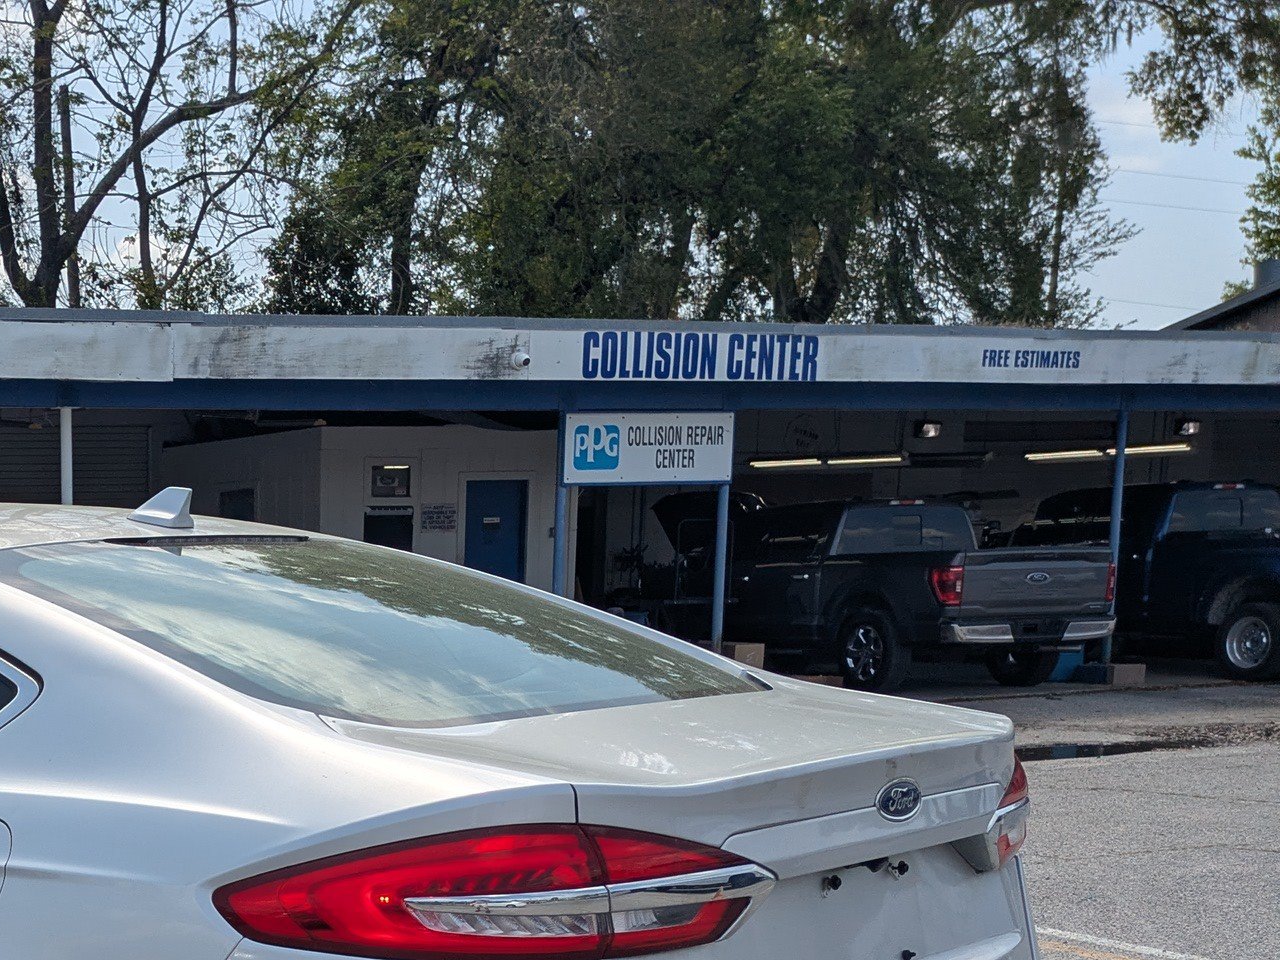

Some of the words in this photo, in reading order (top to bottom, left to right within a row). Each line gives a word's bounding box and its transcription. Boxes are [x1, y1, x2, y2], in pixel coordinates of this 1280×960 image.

[582, 331, 718, 380] COLLISION
[726, 333, 819, 382] CENTER
[982, 349, 1011, 368] FREE
[1014, 350, 1081, 369] ESTIMATES
[574, 424, 619, 463] PPG
[627, 426, 682, 446] COLLISION
[686, 425, 724, 446] REPAIR
[655, 449, 695, 469] CENTER
[888, 787, 914, 812] Ford
